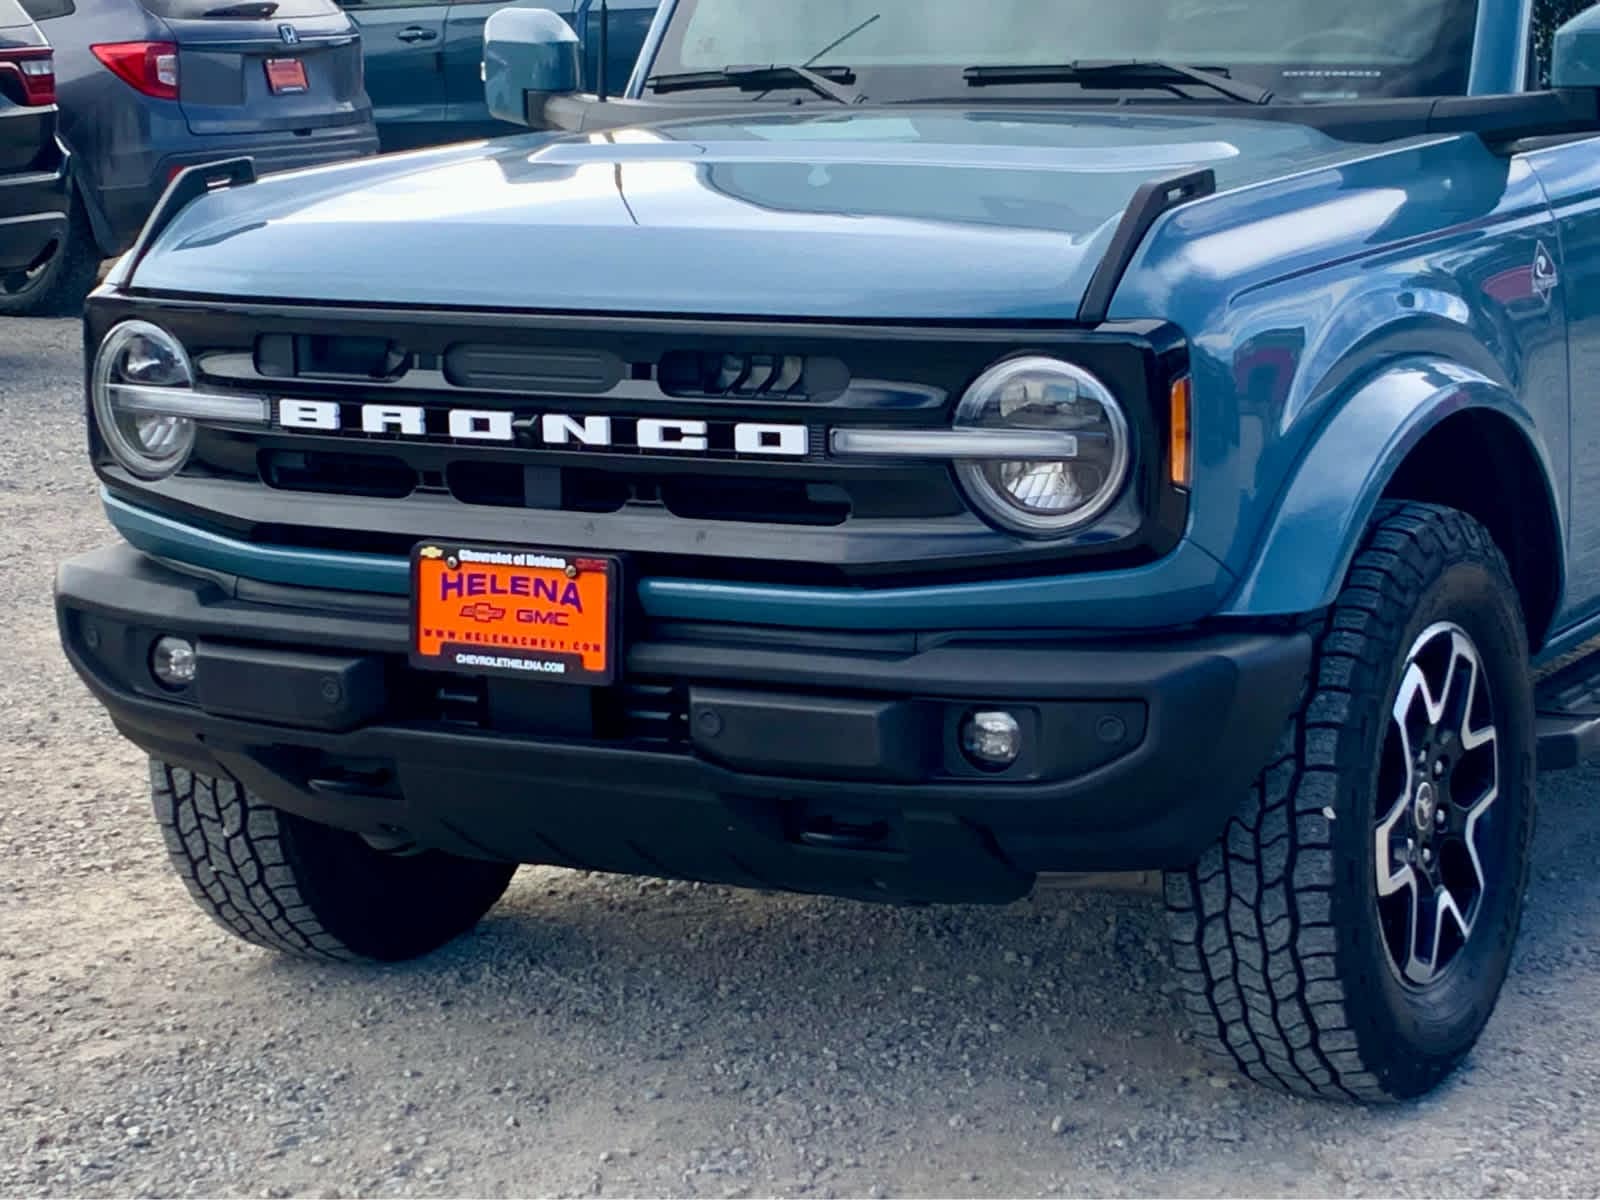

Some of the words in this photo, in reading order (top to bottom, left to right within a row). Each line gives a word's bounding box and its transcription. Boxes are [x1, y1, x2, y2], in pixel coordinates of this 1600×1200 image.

[279, 398, 809, 455] BRONCO
[458, 549, 513, 565] Chevrolet
[513, 553, 525, 566] of
[526, 554, 566, 569] Helena
[441, 572, 583, 614] HELENA
[516, 608, 569, 626] GMC
[423, 628, 601, 653] WWW.HELENACHEVY.COM
[455, 652, 565, 673] CHEVROLETHELENA.COM
